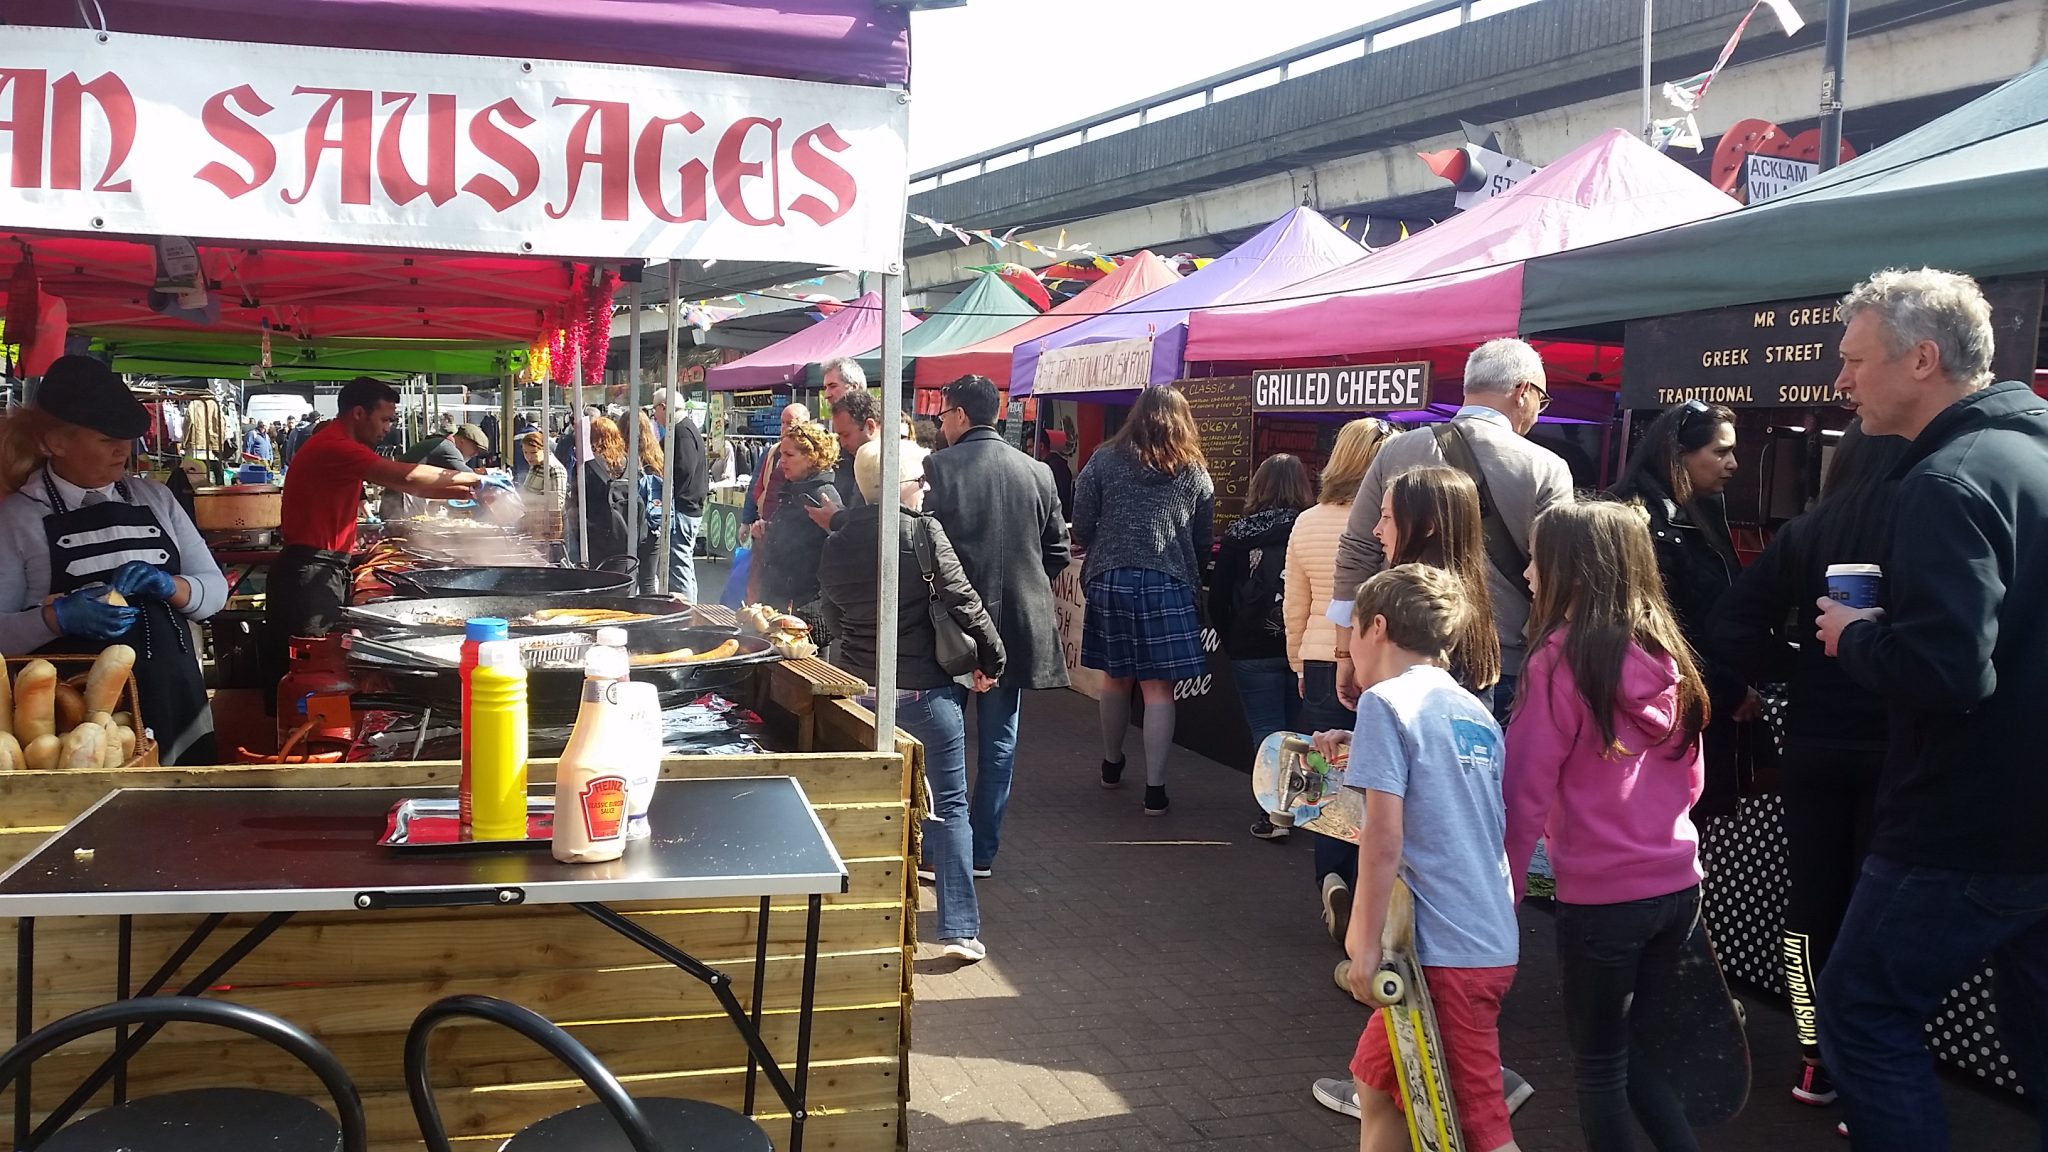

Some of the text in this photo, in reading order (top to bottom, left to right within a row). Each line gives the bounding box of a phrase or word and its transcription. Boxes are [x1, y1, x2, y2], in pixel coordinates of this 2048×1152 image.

[194, 83, 857, 229] SAUSAGES
[1750, 158, 1808, 182] ACKLAM
[1754, 307, 1842, 328] MR GREEK
[1702, 343, 1823, 367] GREEK STREET
[1256, 368, 1421, 406] GRILLED CHEESE
[1658, 386, 1753, 404] TRADITIONAL
[1226, 480, 1237, 494] 6
[594, 780, 623, 793] HEINZ
[1783, 937, 1812, 1004] VICTORIA
